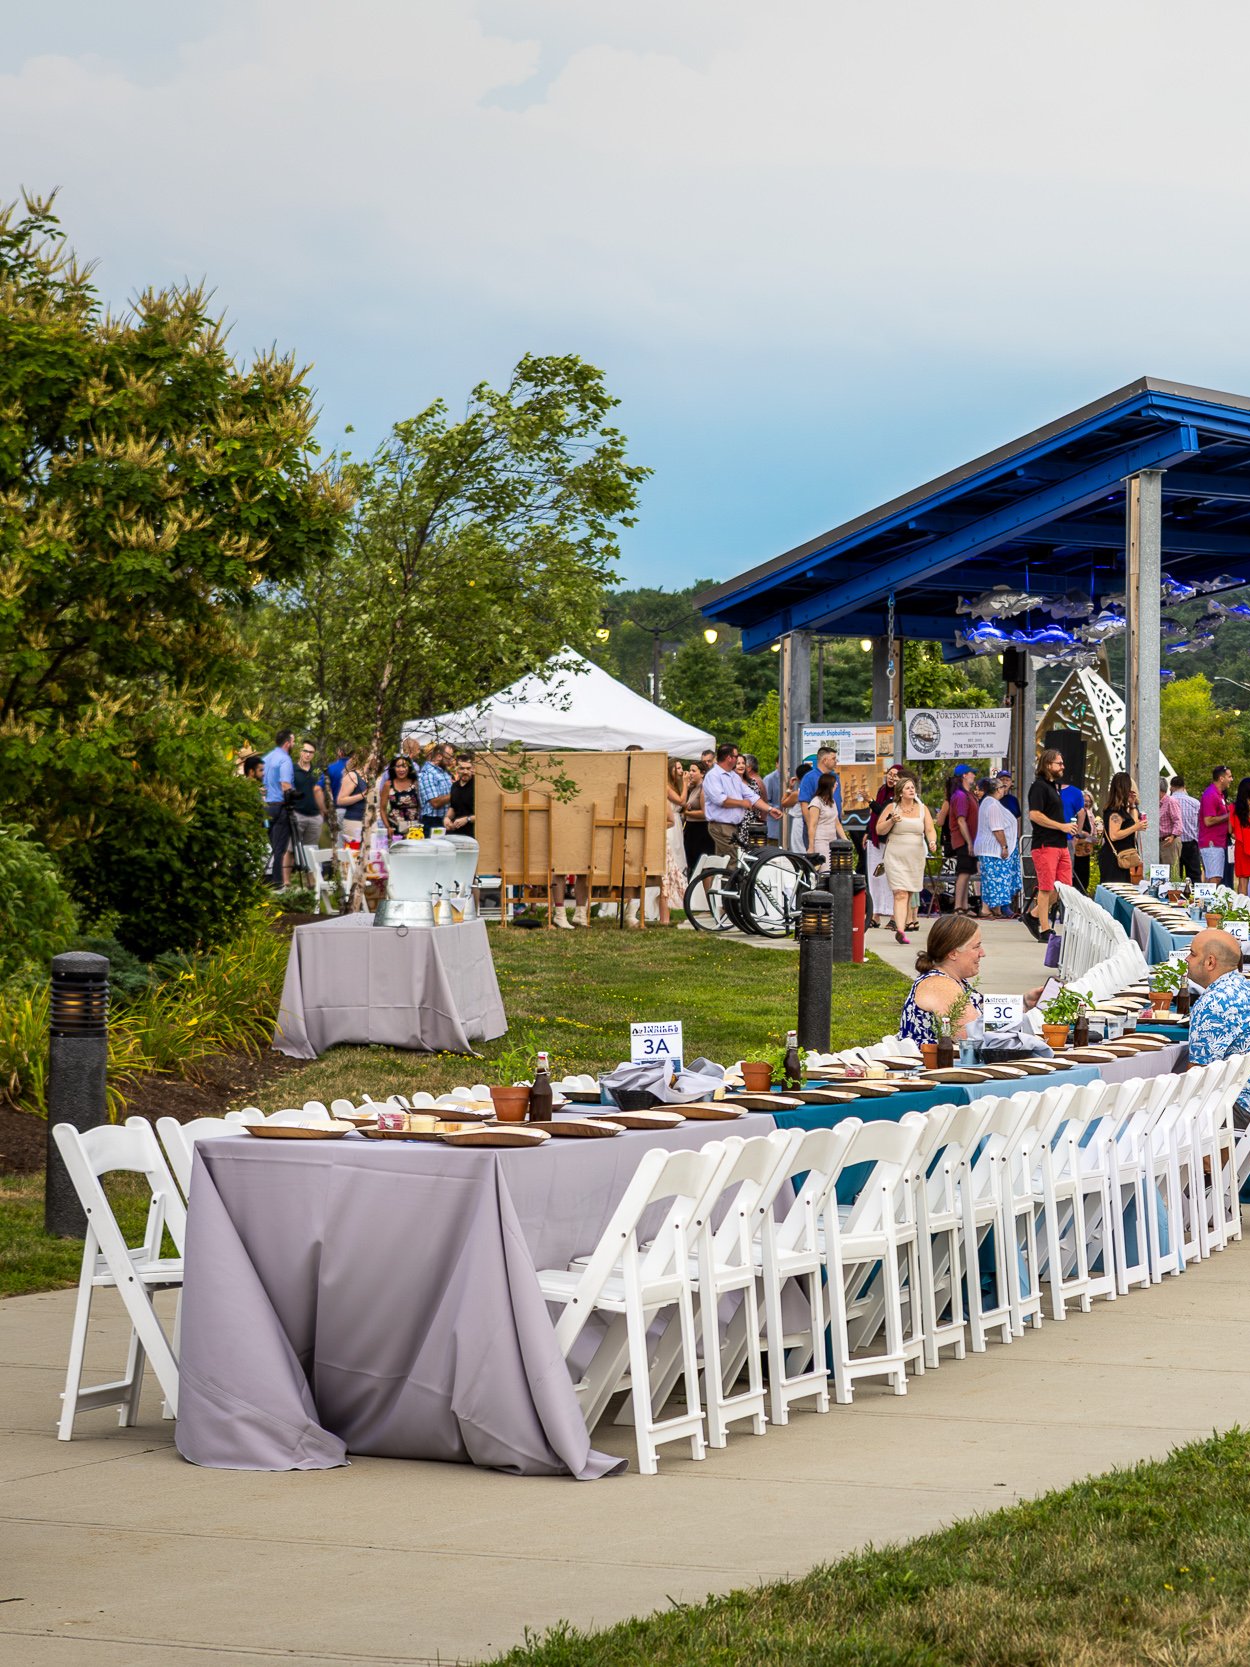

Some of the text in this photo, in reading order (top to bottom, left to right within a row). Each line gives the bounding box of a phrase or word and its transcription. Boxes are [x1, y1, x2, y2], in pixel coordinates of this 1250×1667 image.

[953, 720, 996, 728] FOLK FESTIVAL
[826, 729, 851, 738] Shipbuilding
[1229, 928, 1242, 937] 4C
[994, 1006, 1012, 1018] 3C
[643, 1038, 670, 1055] 3A
